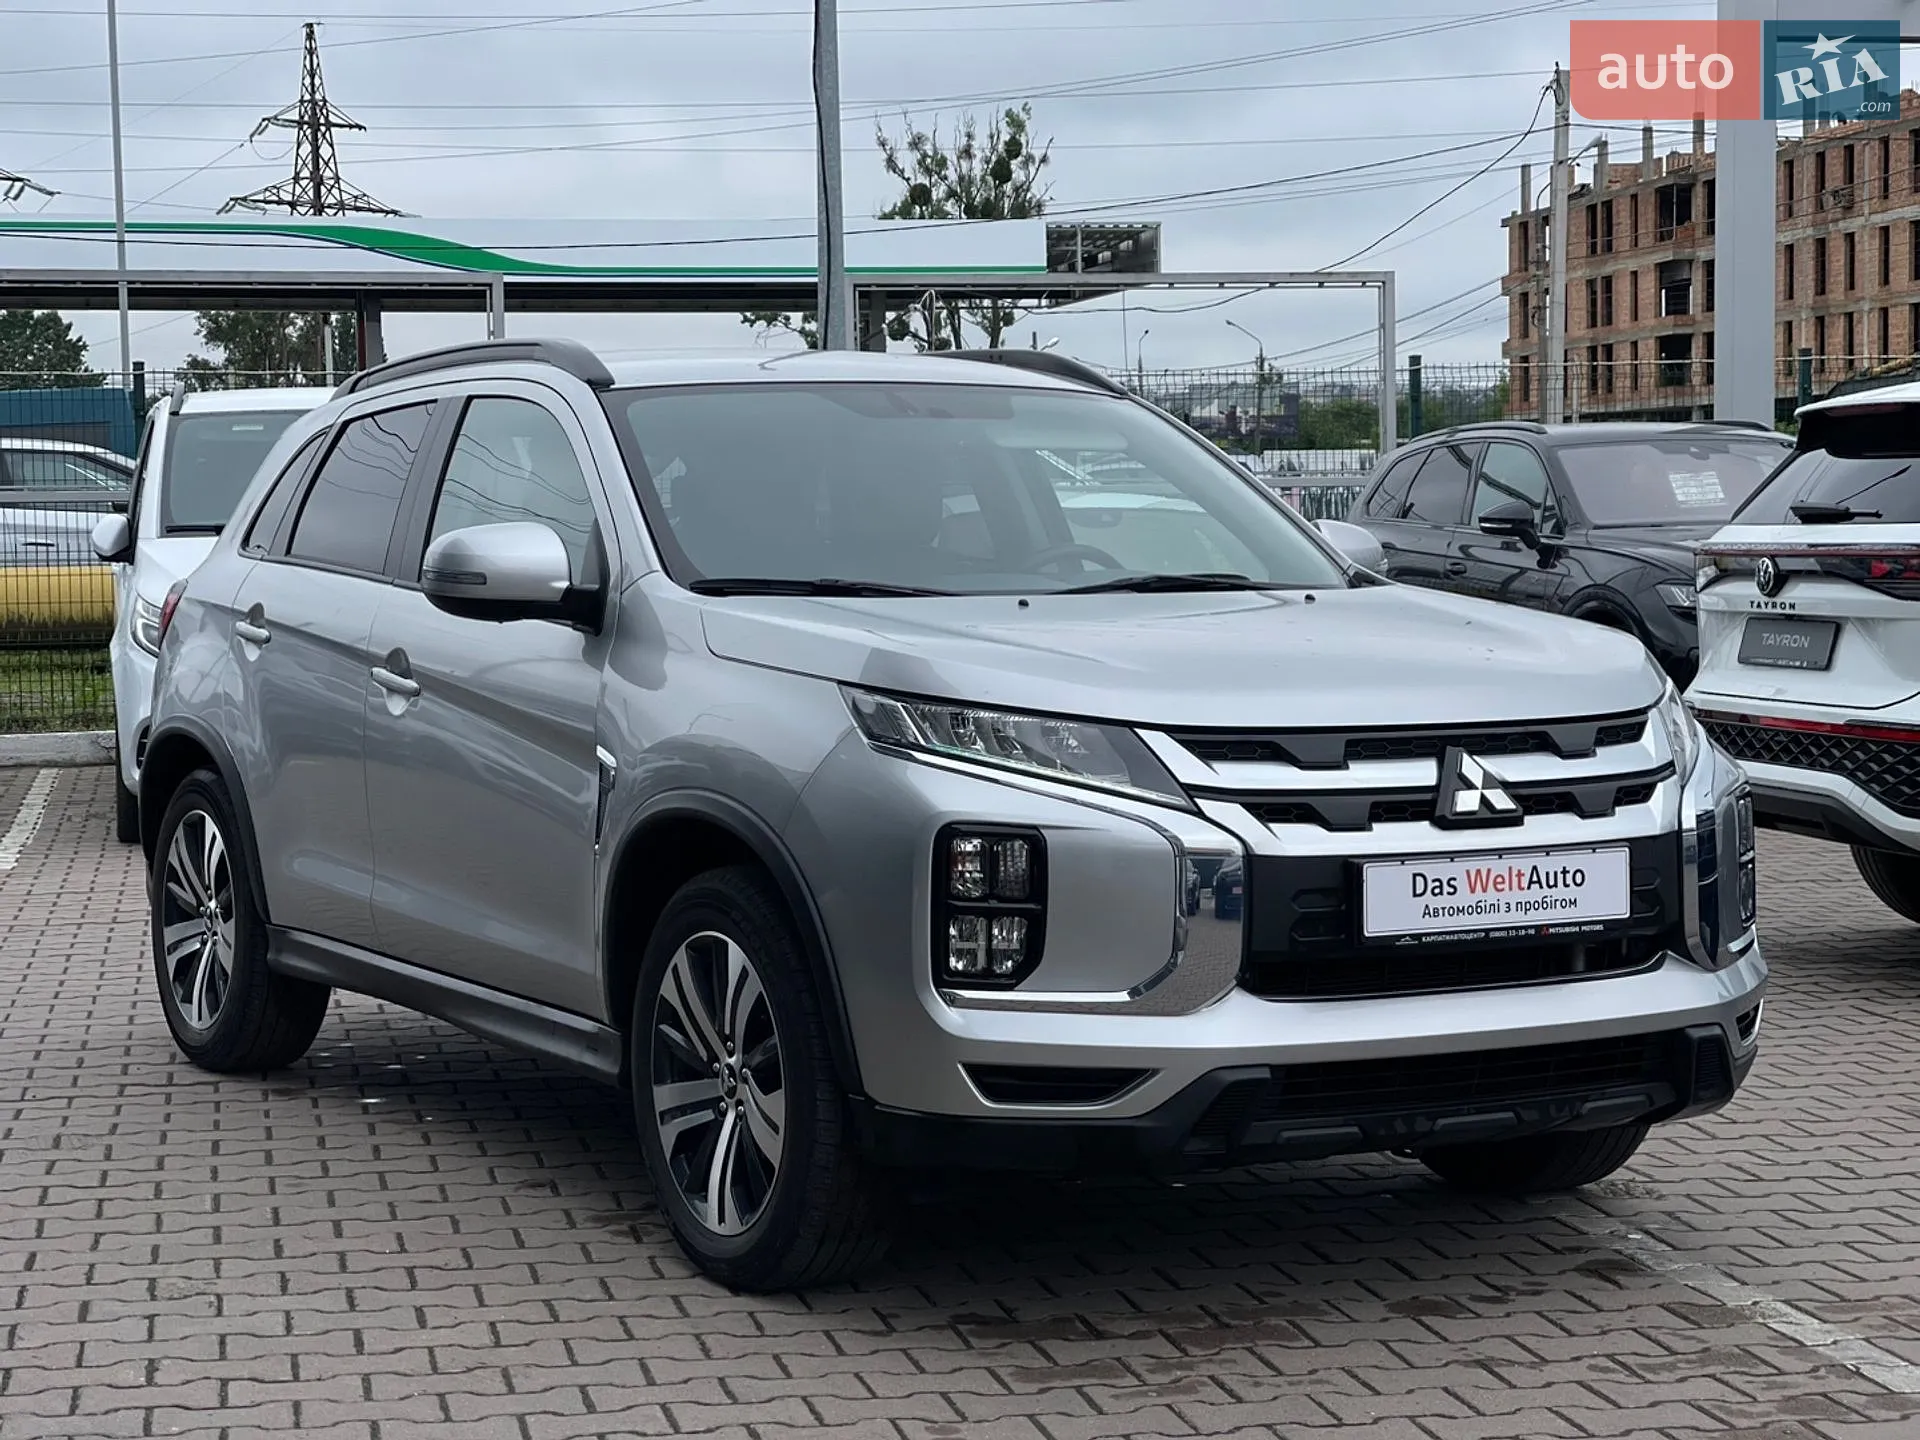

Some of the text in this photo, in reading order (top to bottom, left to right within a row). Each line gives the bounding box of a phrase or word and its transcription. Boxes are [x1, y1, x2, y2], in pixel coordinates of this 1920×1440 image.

[1749, 600, 1796, 611] TAYRON
[1761, 632, 1811, 649] TAYRON
[1411, 864, 1586, 898] Das WeltAuto
[1422, 895, 1577, 919] Автомобілі з пробігом
